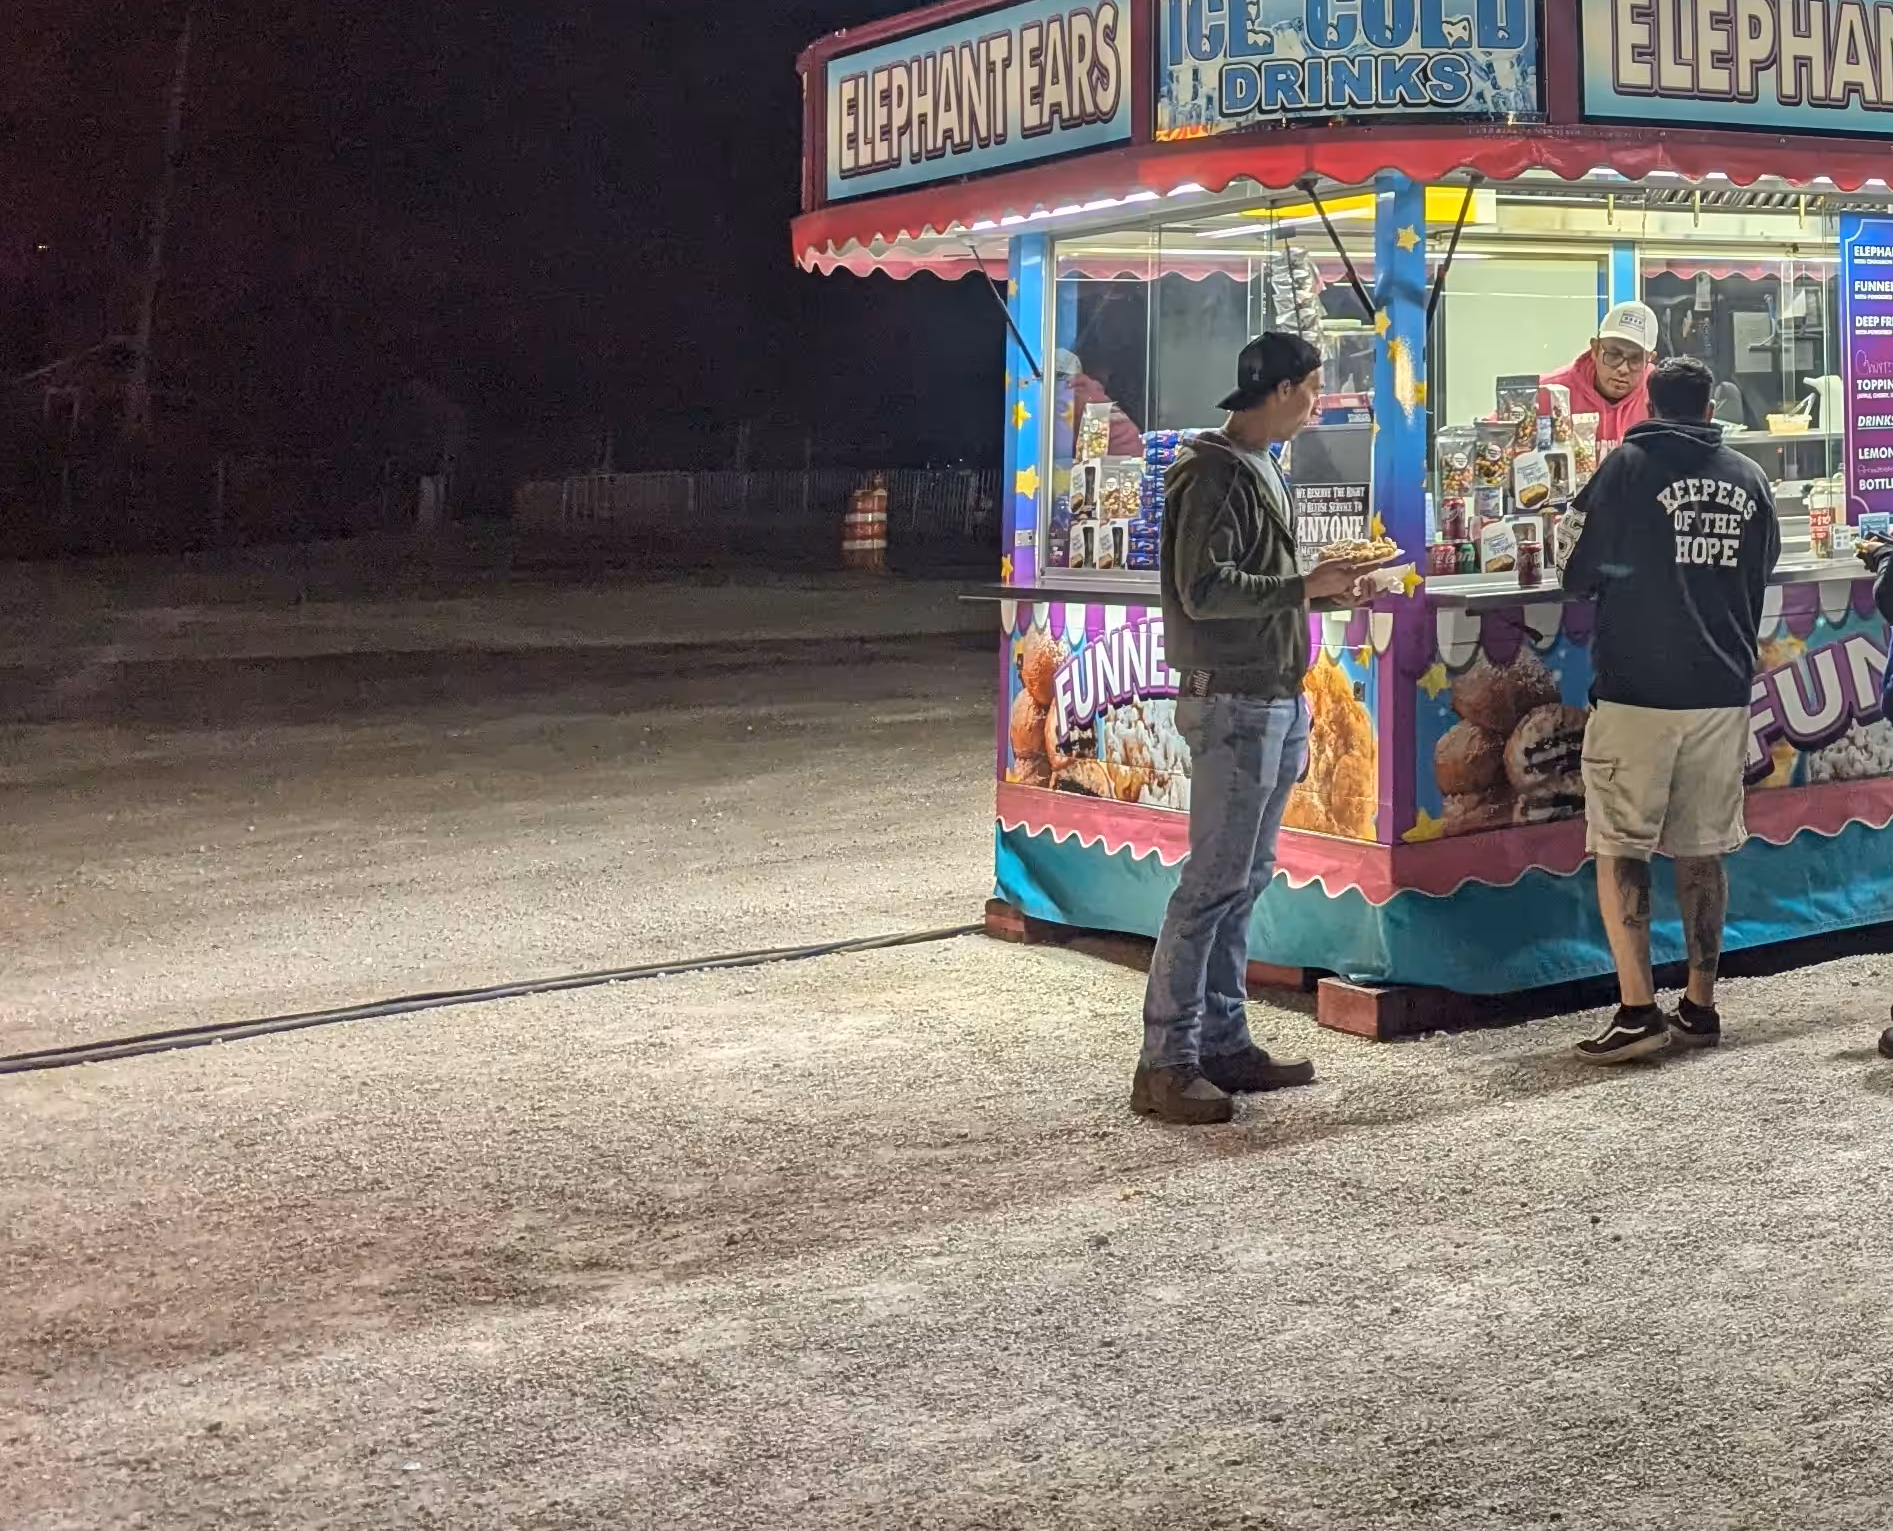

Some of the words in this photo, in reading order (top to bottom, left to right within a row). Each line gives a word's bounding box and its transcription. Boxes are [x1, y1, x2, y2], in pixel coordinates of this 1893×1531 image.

[837, 28, 1015, 179] ELEPHANT
[1217, 51, 1473, 119] DRINKS
[1855, 315, 1881, 327] DEEP
[1656, 478, 1757, 521] KEEPERS
[1297, 516, 1365, 543] ANYONE
[1674, 509, 1696, 532] OF
[1701, 512, 1742, 535] THE
[1675, 535, 1740, 568] HOPE
[1054, 617, 1182, 743] FUNNE
